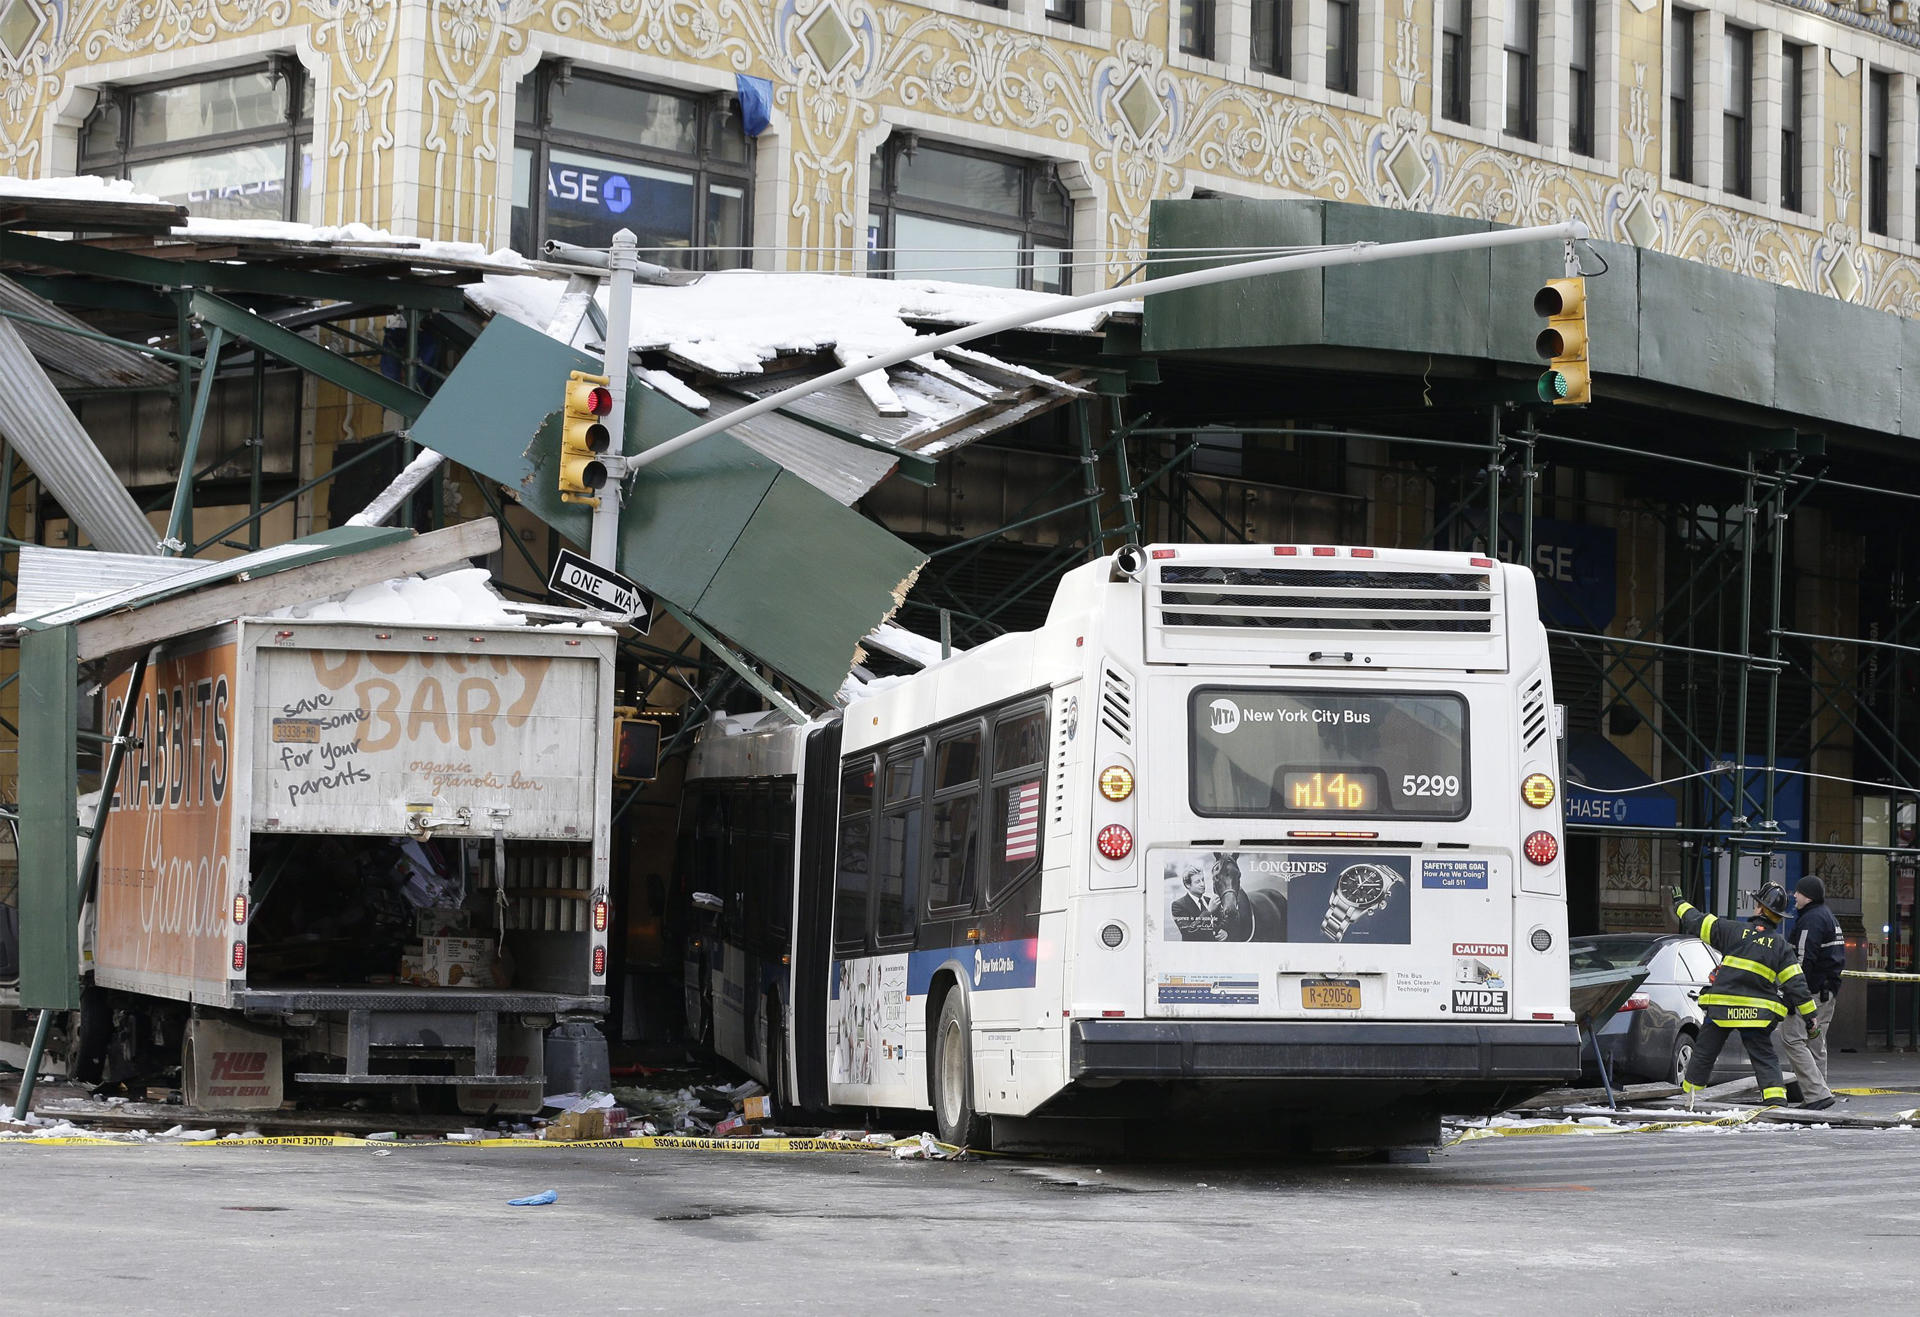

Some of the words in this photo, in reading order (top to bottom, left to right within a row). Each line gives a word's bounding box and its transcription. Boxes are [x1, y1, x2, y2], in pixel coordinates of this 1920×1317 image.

[570, 569, 603, 595] ONE
[613, 588, 641, 615] WAY
[283, 693, 334, 718] save
[319, 707, 371, 731] some
[354, 676, 501, 753] BAR
[1208, 705, 1236, 728] MTA
[1243, 708, 1274, 723] New
[1276, 709, 1309, 723] York
[1311, 709, 1341, 725] City
[1343, 710, 1371, 724] Bus
[279, 746, 314, 772] for
[320, 738, 362, 771] your
[409, 759, 473, 780] organic
[287, 761, 371, 807] parents
[431, 772, 505, 797] granola
[507, 770, 544, 792] bar
[1294, 772, 1363, 808] M14D
[1401, 774, 1460, 797] 5299
[1250, 861, 1327, 874] LONGINES
[1424, 862, 1453, 870] SAFETY'S
[1463, 871, 1485, 879] Doing?
[1455, 944, 1505, 955] CAUTION
[1455, 991, 1504, 1006] WIDE
[1727, 1007, 1758, 1019] MORRIS
[210, 1051, 268, 1081] HUB
[303, 1137, 334, 1146] POLICE
[653, 1138, 679, 1147] CROSS
[681, 1139, 697, 1149] NOT
[698, 1139, 710, 1149] DO
[711, 1140, 730, 1150] LINE
[731, 1140, 760, 1150] POLICE
[788, 1140, 814, 1150] CROSS
[815, 1140, 828, 1150] NOT
